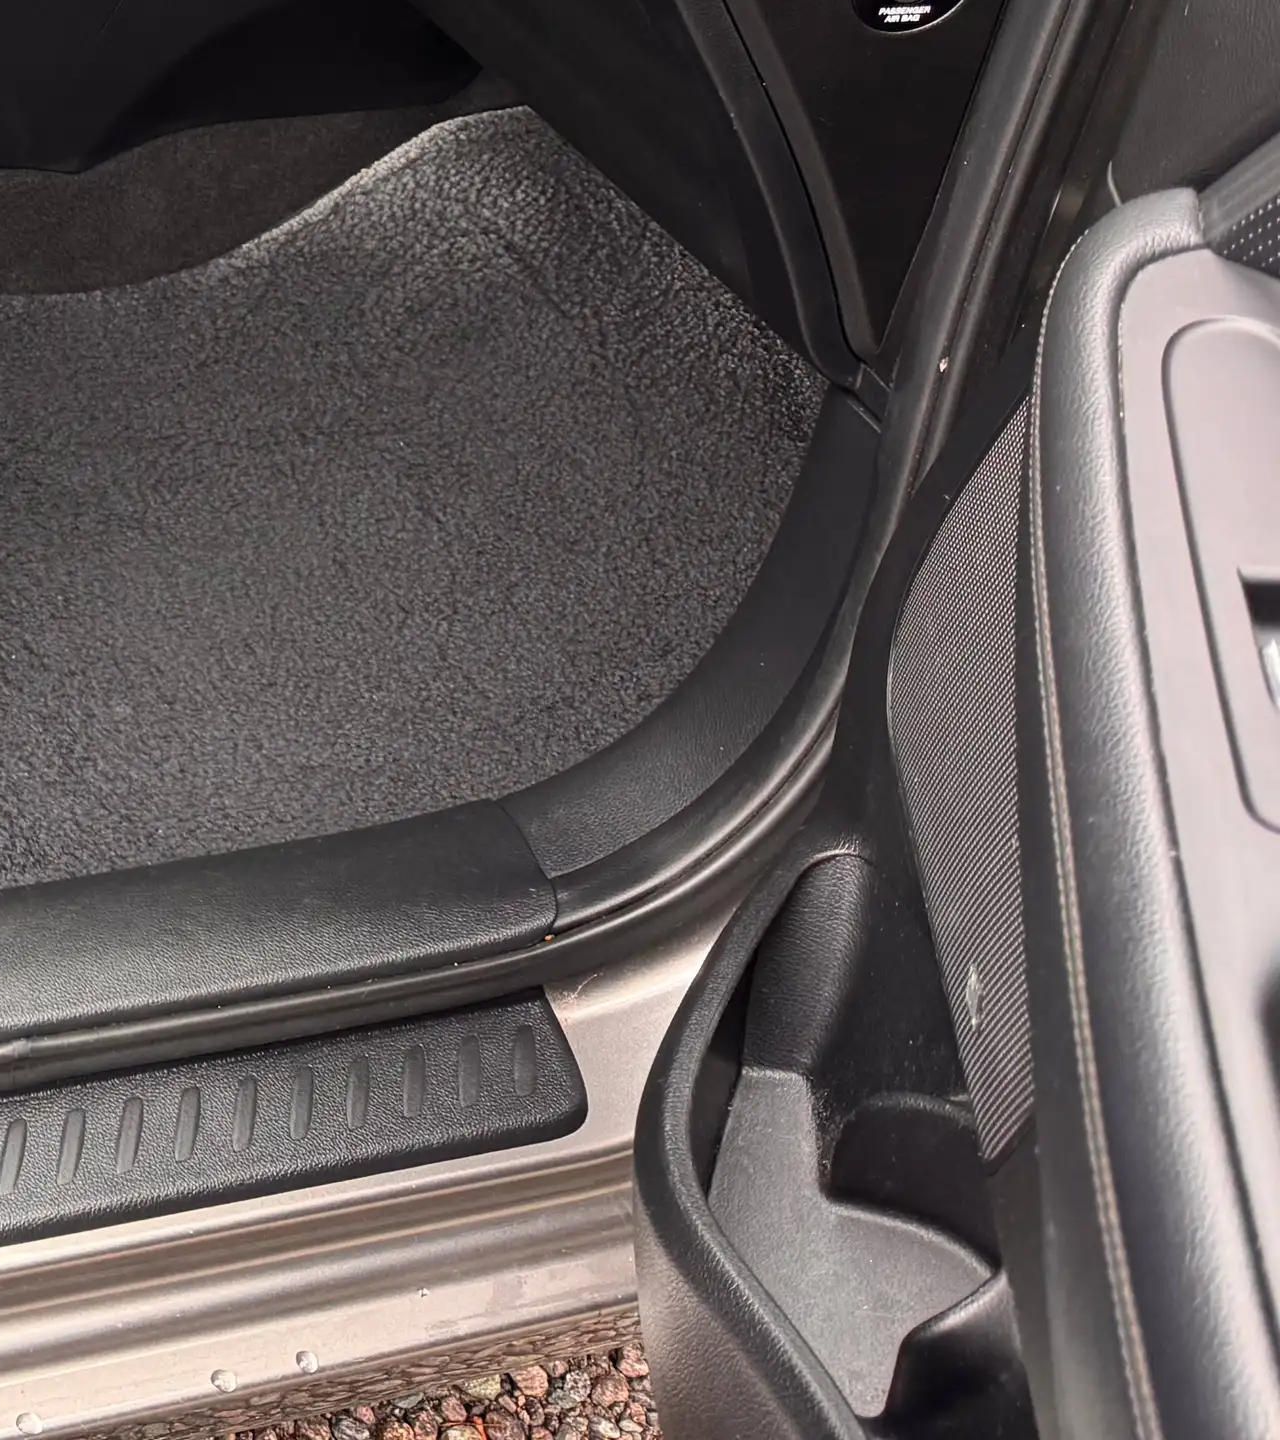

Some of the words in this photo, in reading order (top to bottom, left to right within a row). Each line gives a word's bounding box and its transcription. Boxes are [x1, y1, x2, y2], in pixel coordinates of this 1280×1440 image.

[878, 5, 931, 16] PASSENGER
[884, 15, 900, 23] AIR
[901, 14, 920, 22] BAG
